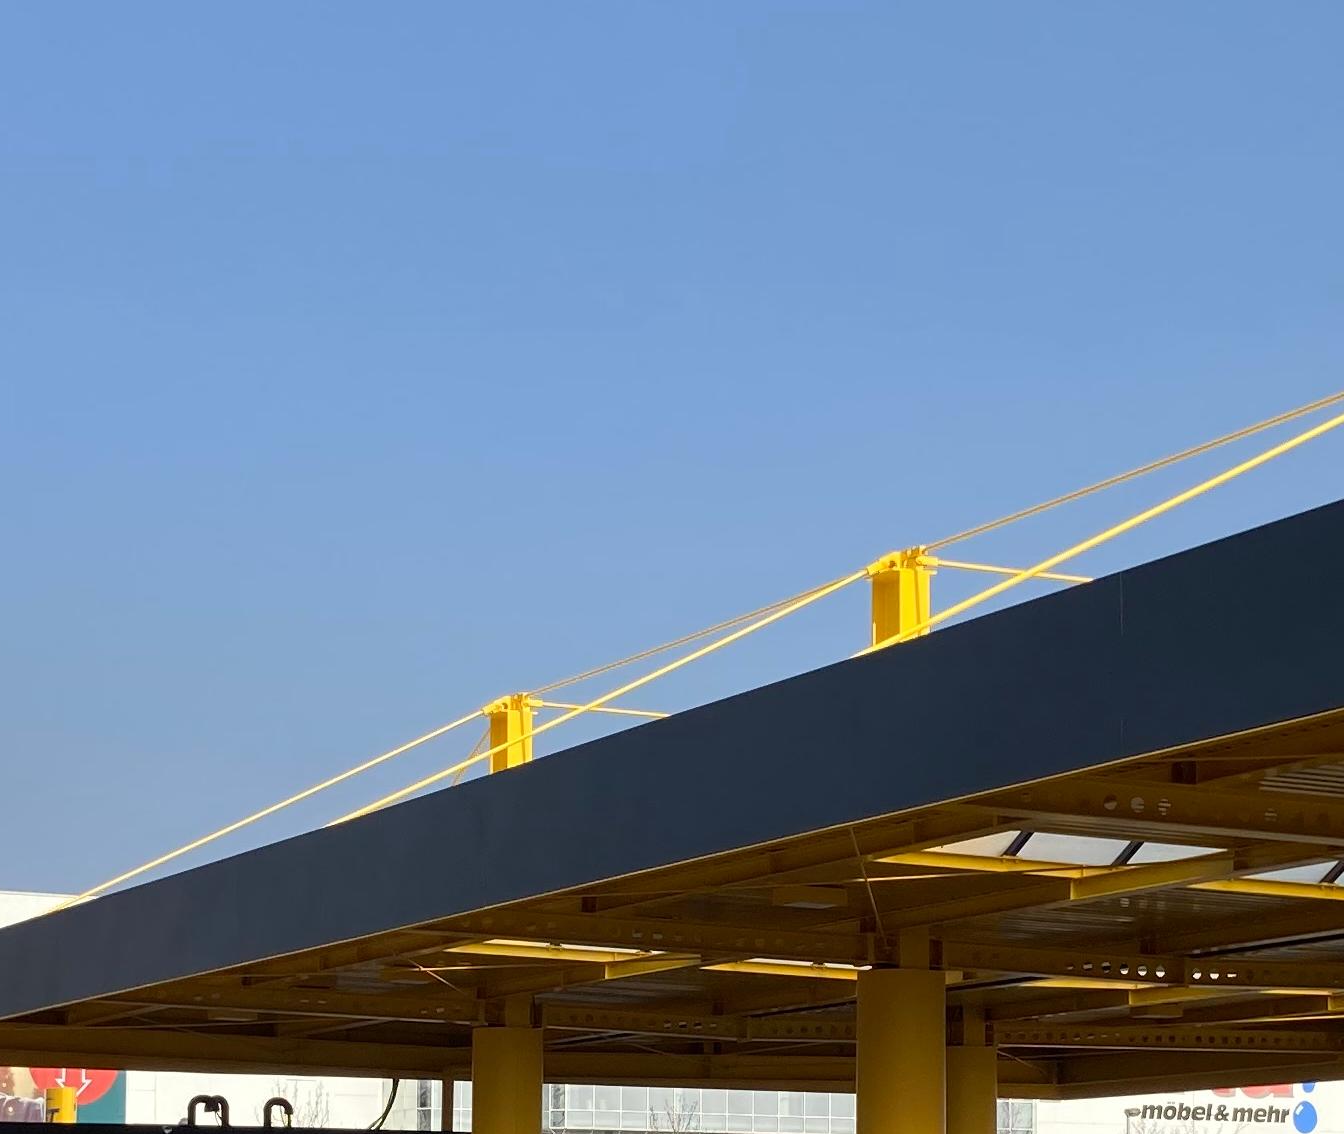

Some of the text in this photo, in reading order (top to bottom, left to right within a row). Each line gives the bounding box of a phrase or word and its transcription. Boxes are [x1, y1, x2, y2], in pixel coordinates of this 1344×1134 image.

[1141, 1102, 1290, 1123] möbel & mehr
